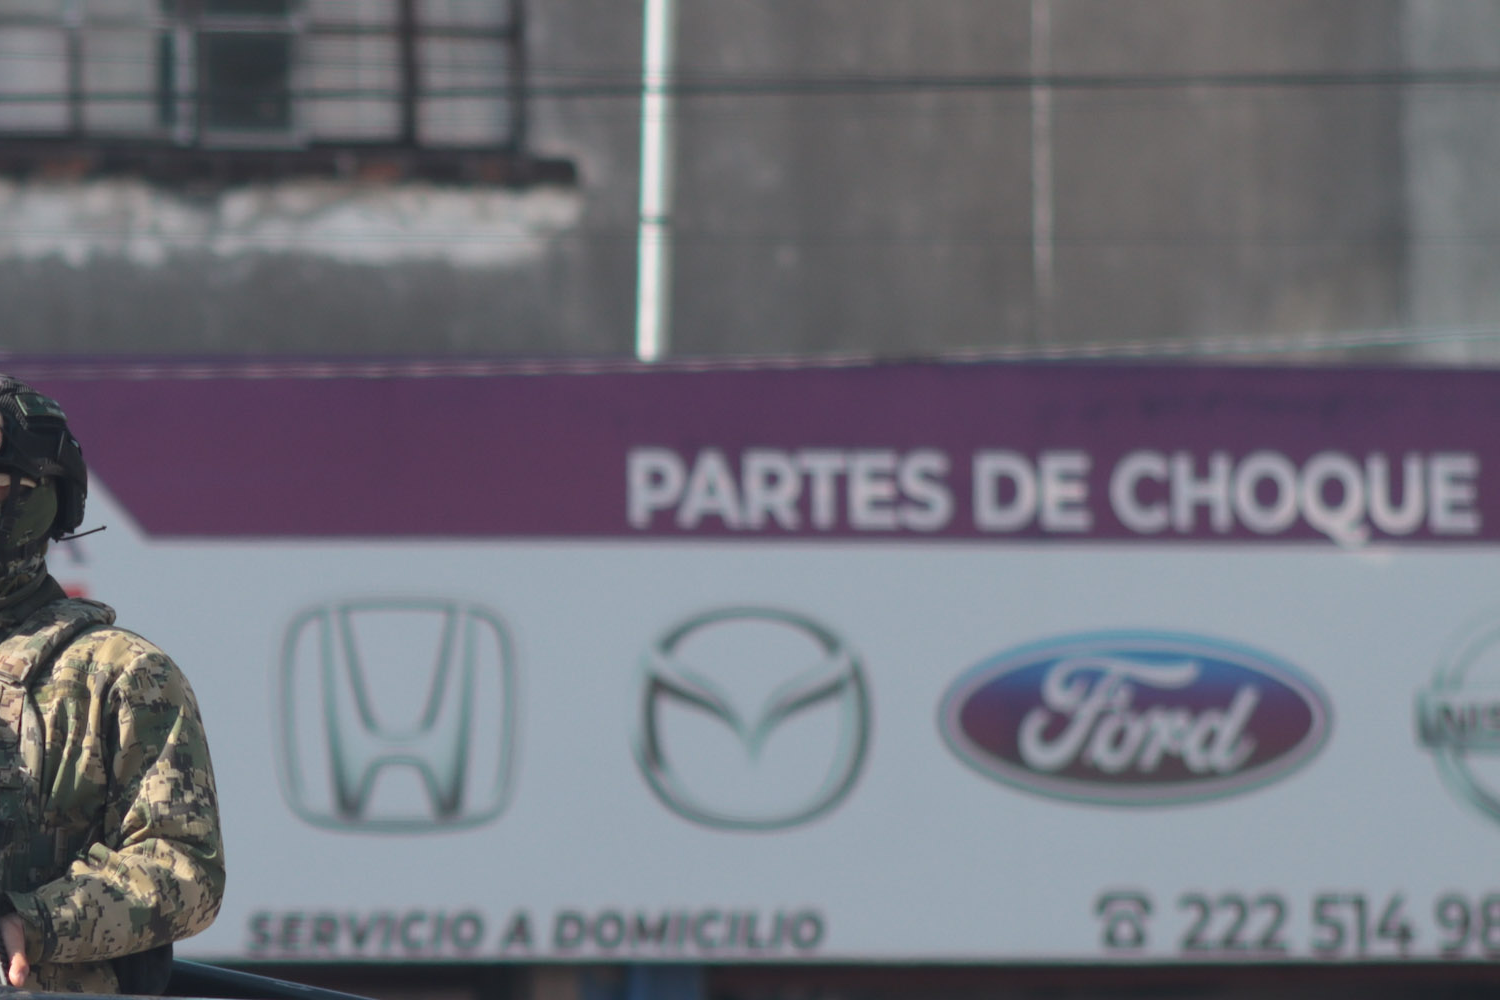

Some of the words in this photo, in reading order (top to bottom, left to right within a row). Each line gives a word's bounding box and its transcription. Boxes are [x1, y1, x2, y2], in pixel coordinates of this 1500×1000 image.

[626, 448, 954, 531] PARTES
[972, 449, 1093, 533] DE
[1109, 449, 1482, 552] CHOQUE
[1016, 656, 1260, 775] Ford
[247, 911, 486, 953] SERVICIO
[504, 911, 534, 951] A
[553, 911, 826, 952] DOMICILIO
[1179, 893, 1289, 953] 222
[1310, 894, 1416, 956] 514
